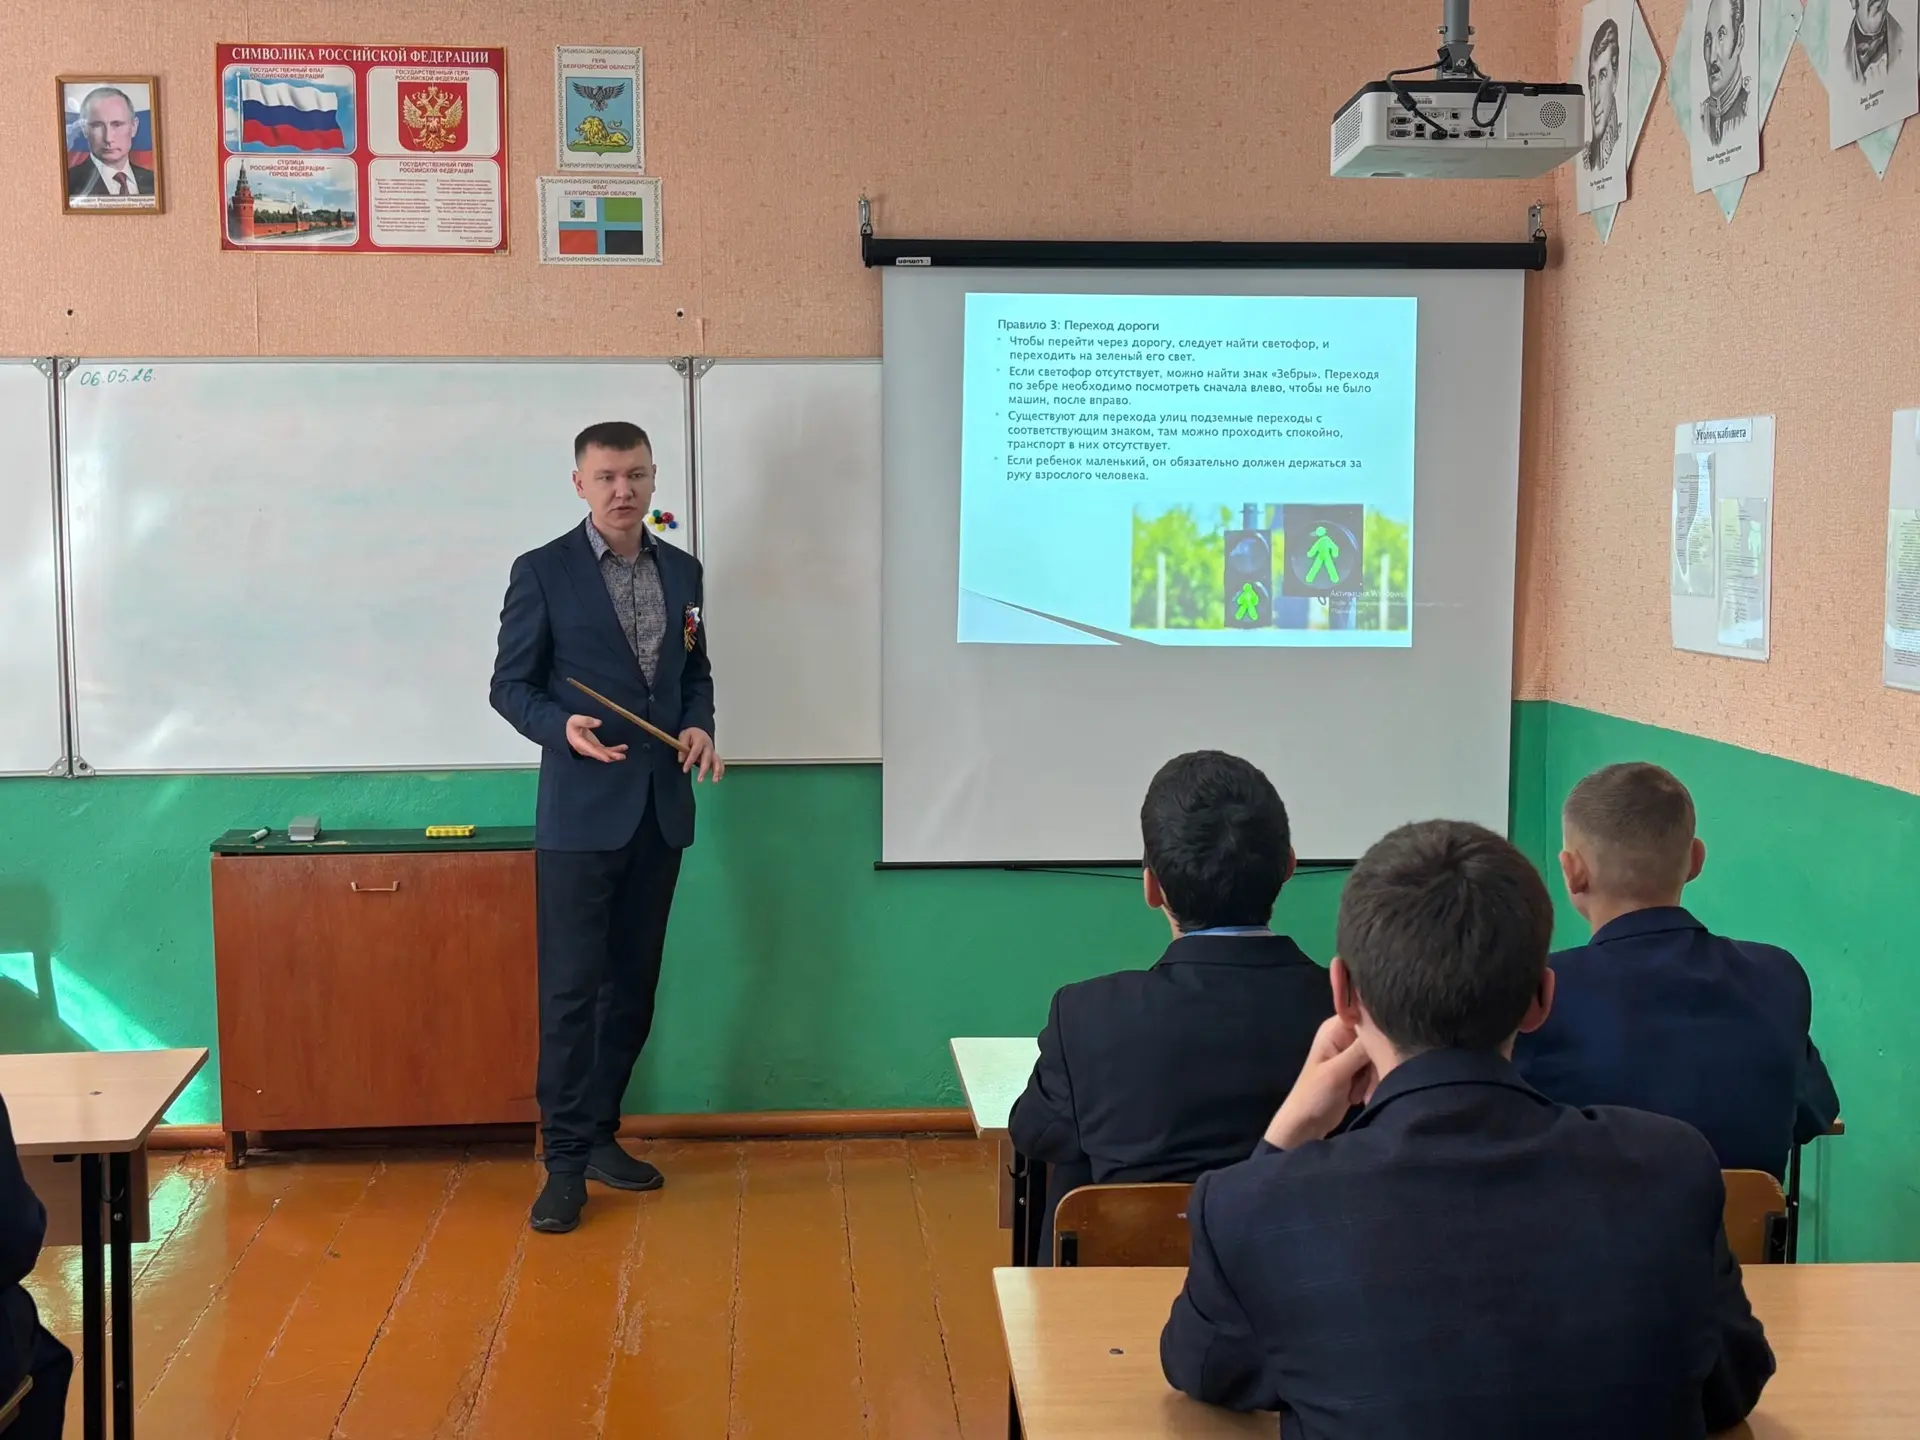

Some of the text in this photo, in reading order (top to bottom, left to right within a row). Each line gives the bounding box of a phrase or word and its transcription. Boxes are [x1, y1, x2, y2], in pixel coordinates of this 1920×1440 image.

[232, 46, 489, 64] СИМВОЛИКА РОССИЙСКОЙ ФЕДЕРАЦИИ
[997, 318, 1159, 334] Правило 3: Переход дороги
[1009, 334, 1330, 351] Чтобы перейти через дорогу, следует найти светофор, и
[1009, 350, 1195, 363] переходить на зеленый его свет.
[80, 368, 156, 386] 06.05.26.
[1008, 365, 1379, 381] Если светофор отсутствует, можно найти знак «Зебры». Переходя
[1008, 379, 1371, 395] по зебре необходимо посмотреть сначала влево, чтобы не было
[1008, 395, 1131, 407] машин, после вправо.
[1007, 410, 1323, 426] Существуют для перехода улиц подземные переходы с
[1007, 426, 1342, 440] соответствующим знаком, там можно проходить спокойно,
[1696, 426, 1746, 441] Уголок кабинета
[1006, 440, 1170, 454] транспорт в них отсутствует.
[1007, 454, 1362, 471] Если ребенок маленький, он обязательно должен держаться за
[1006, 470, 1148, 483] руку взрослого человека.
